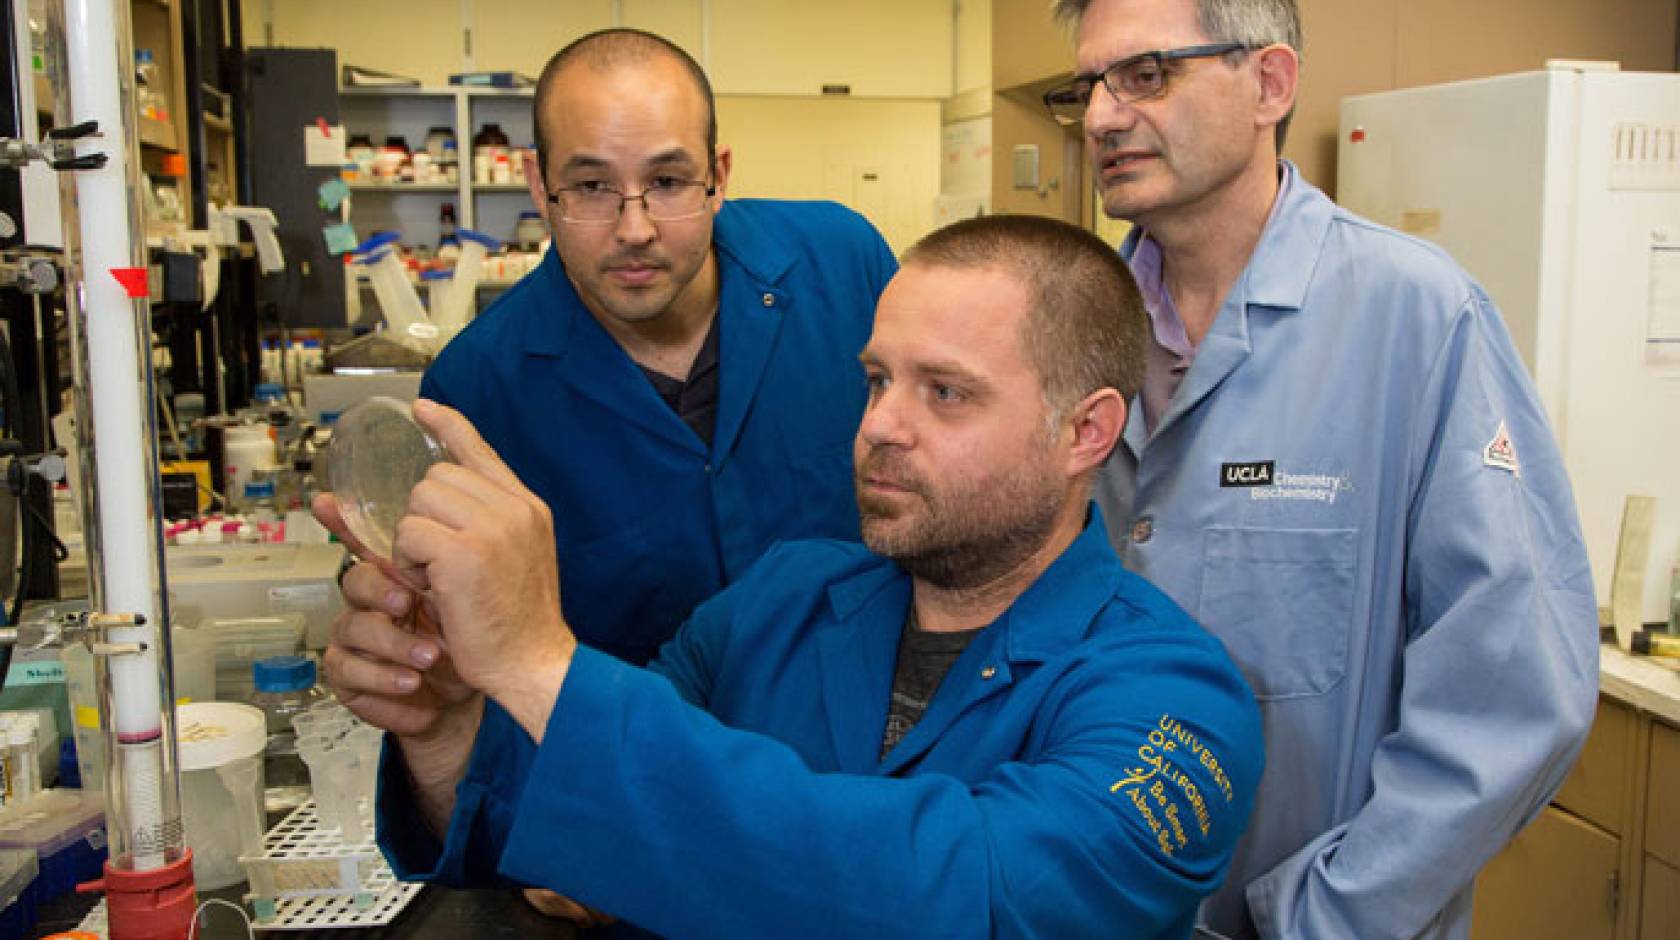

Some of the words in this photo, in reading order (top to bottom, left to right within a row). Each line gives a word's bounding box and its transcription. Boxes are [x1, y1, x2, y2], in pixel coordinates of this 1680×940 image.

[1226, 464, 1270, 482] UCLA
[1274, 471, 1341, 492] Chemistry
[1250, 486, 1336, 505] Biochemistry
[1148, 729, 1177, 752] OF
[1159, 713, 1233, 803] UNIVERSITY
[1150, 780, 1167, 807] Be
[1125, 787, 1162, 833] About
